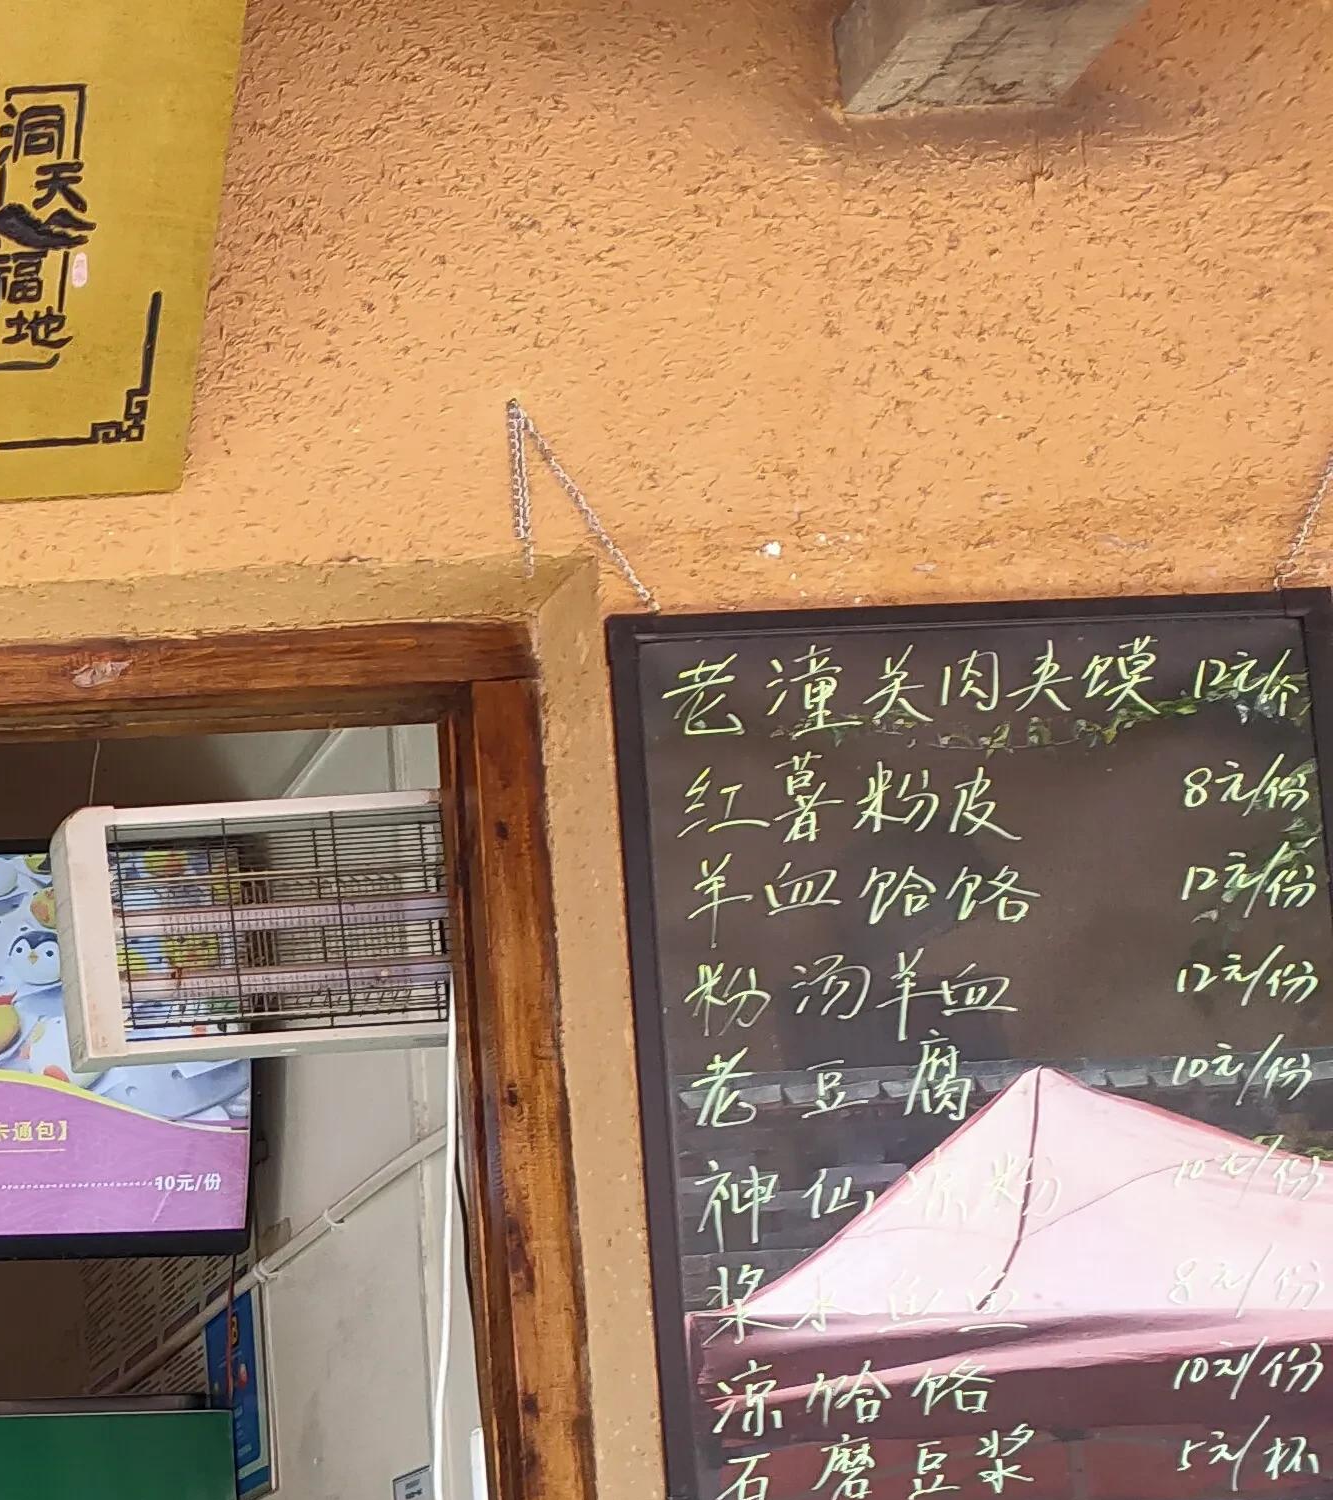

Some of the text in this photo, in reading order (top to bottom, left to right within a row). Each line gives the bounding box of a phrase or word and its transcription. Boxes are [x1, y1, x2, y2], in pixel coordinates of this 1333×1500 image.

[663, 637, 1161, 738] 老潼关肉夹馍
[678, 753, 1311, 842] 红薯粉皮 8元/份
[1181, 840, 1318, 918] 12元/份
[1175, 944, 1320, 1007] 12元/份
[694, 1028, 1314, 1128] 老豆腐 10元/份
[154, 1172, 222, 1193] 10元/份
[1172, 1335, 1325, 1400] 10元/份
[1176, 1414, 1320, 1492] 5元/杯
